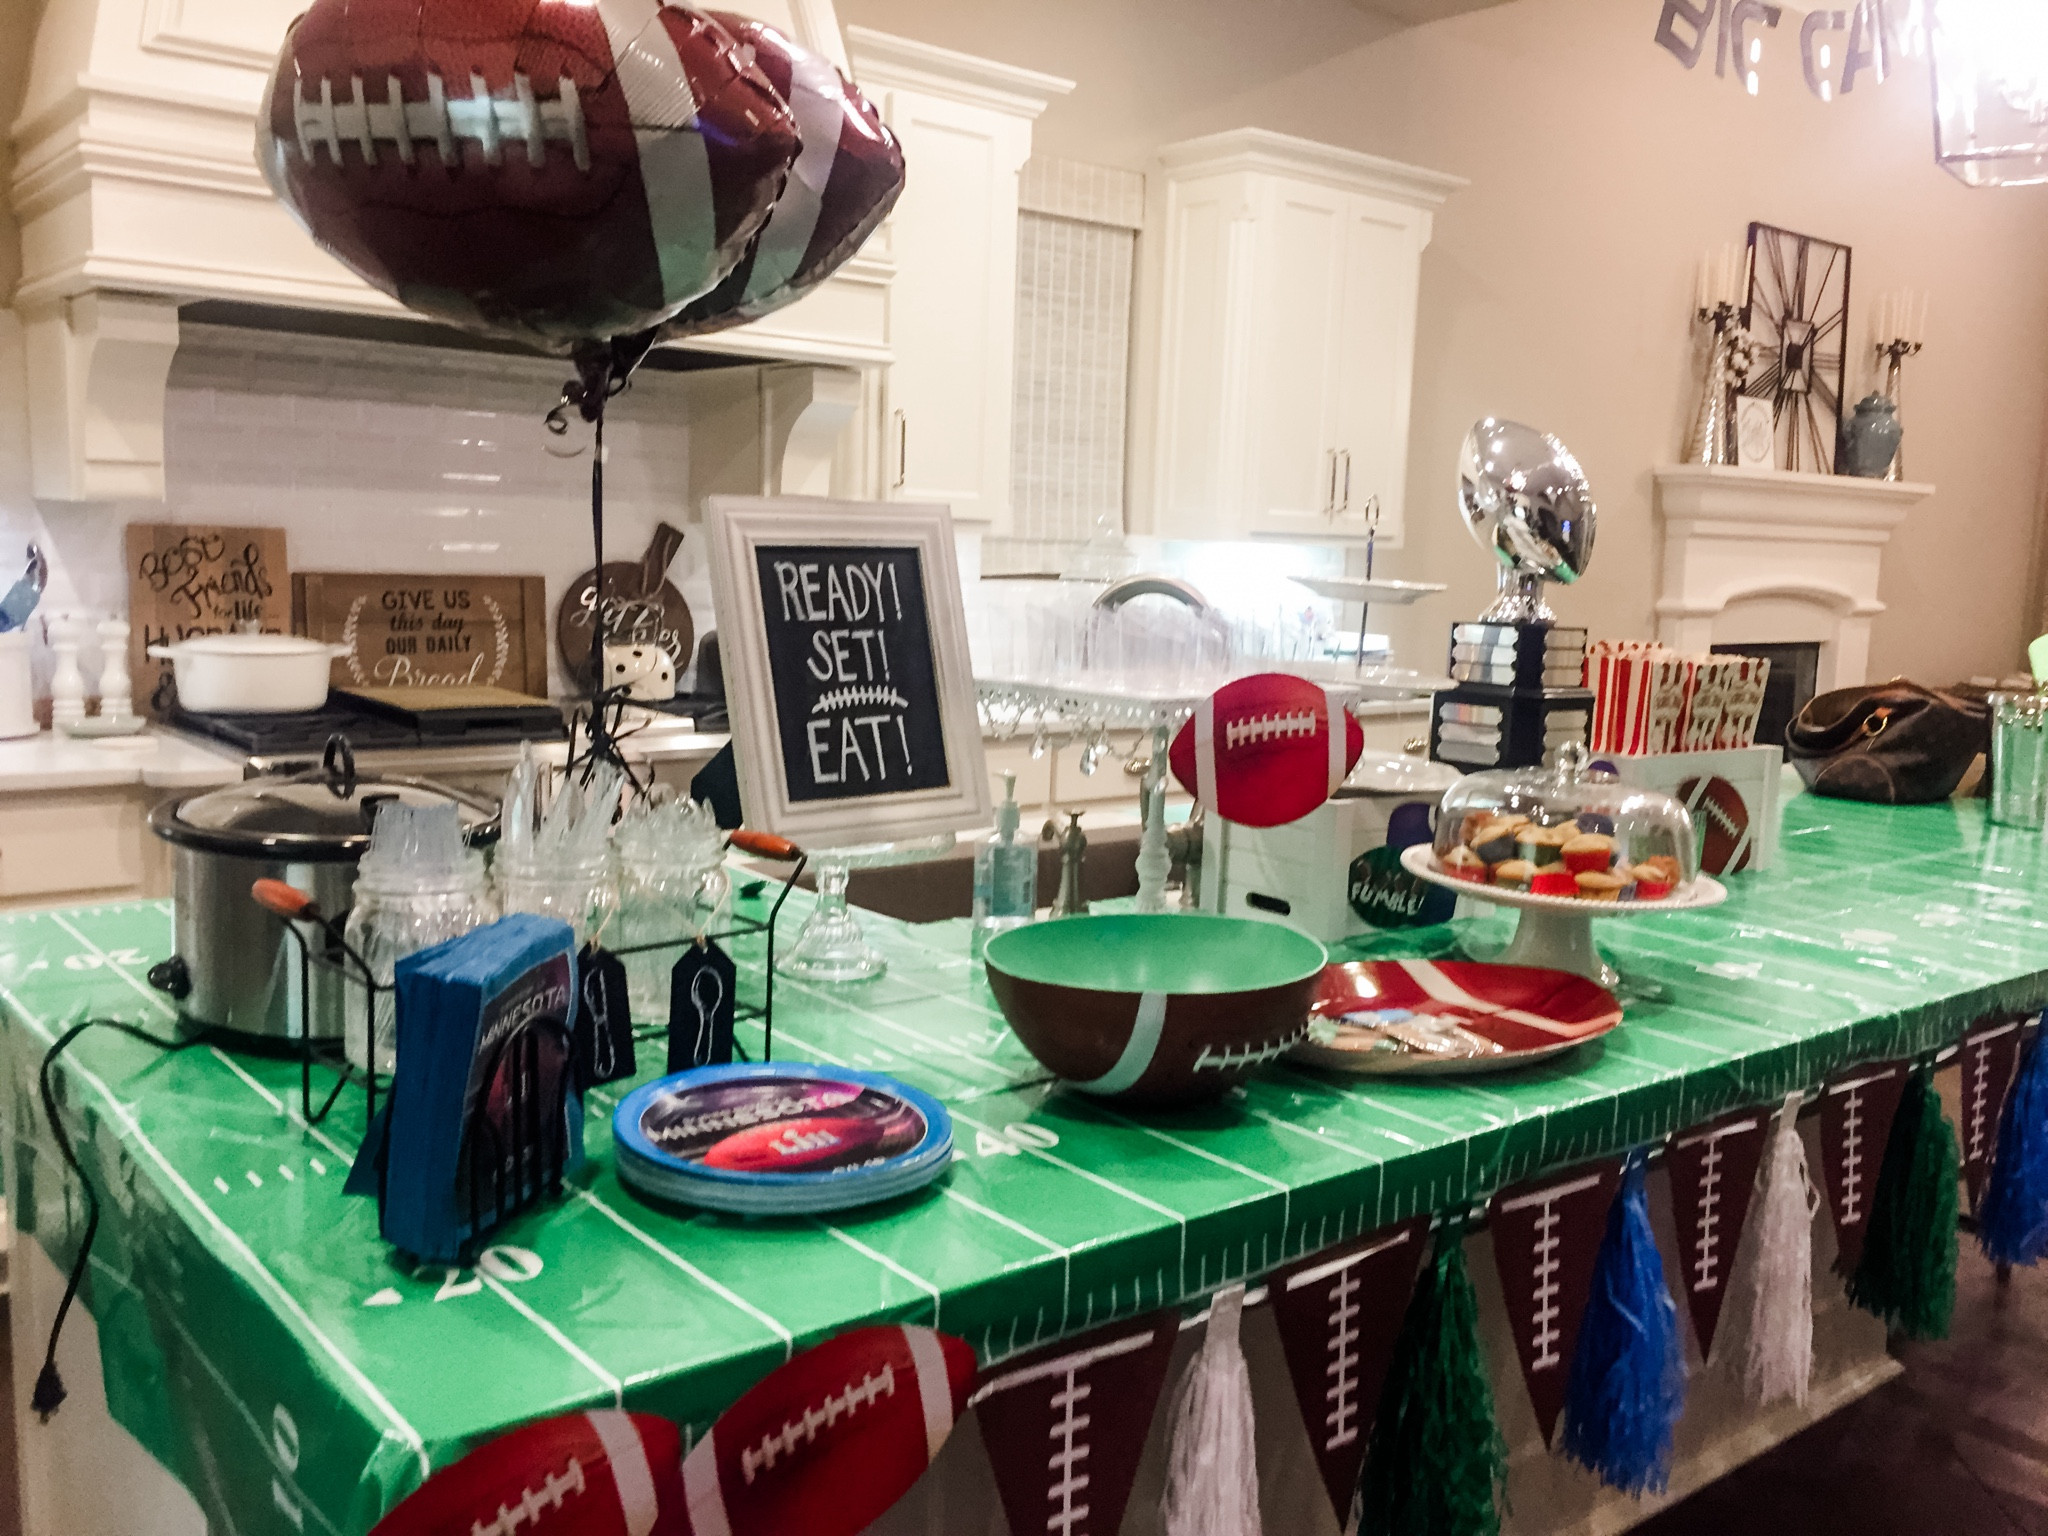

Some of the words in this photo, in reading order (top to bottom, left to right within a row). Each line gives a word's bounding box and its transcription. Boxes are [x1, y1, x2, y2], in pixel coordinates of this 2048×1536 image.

[381, 590, 435, 610] GIVE
[443, 589, 471, 610] US
[773, 561, 902, 622] READY!
[389, 613, 424, 632] this
[431, 612, 464, 635] day
[386, 636, 417, 655] OUR
[426, 635, 472, 653] DAILY
[806, 629, 891, 682] SET!
[374, 652, 485, 687] Bread
[806, 714, 913, 784] EAT!
[975, 1122, 1060, 1157] 40
